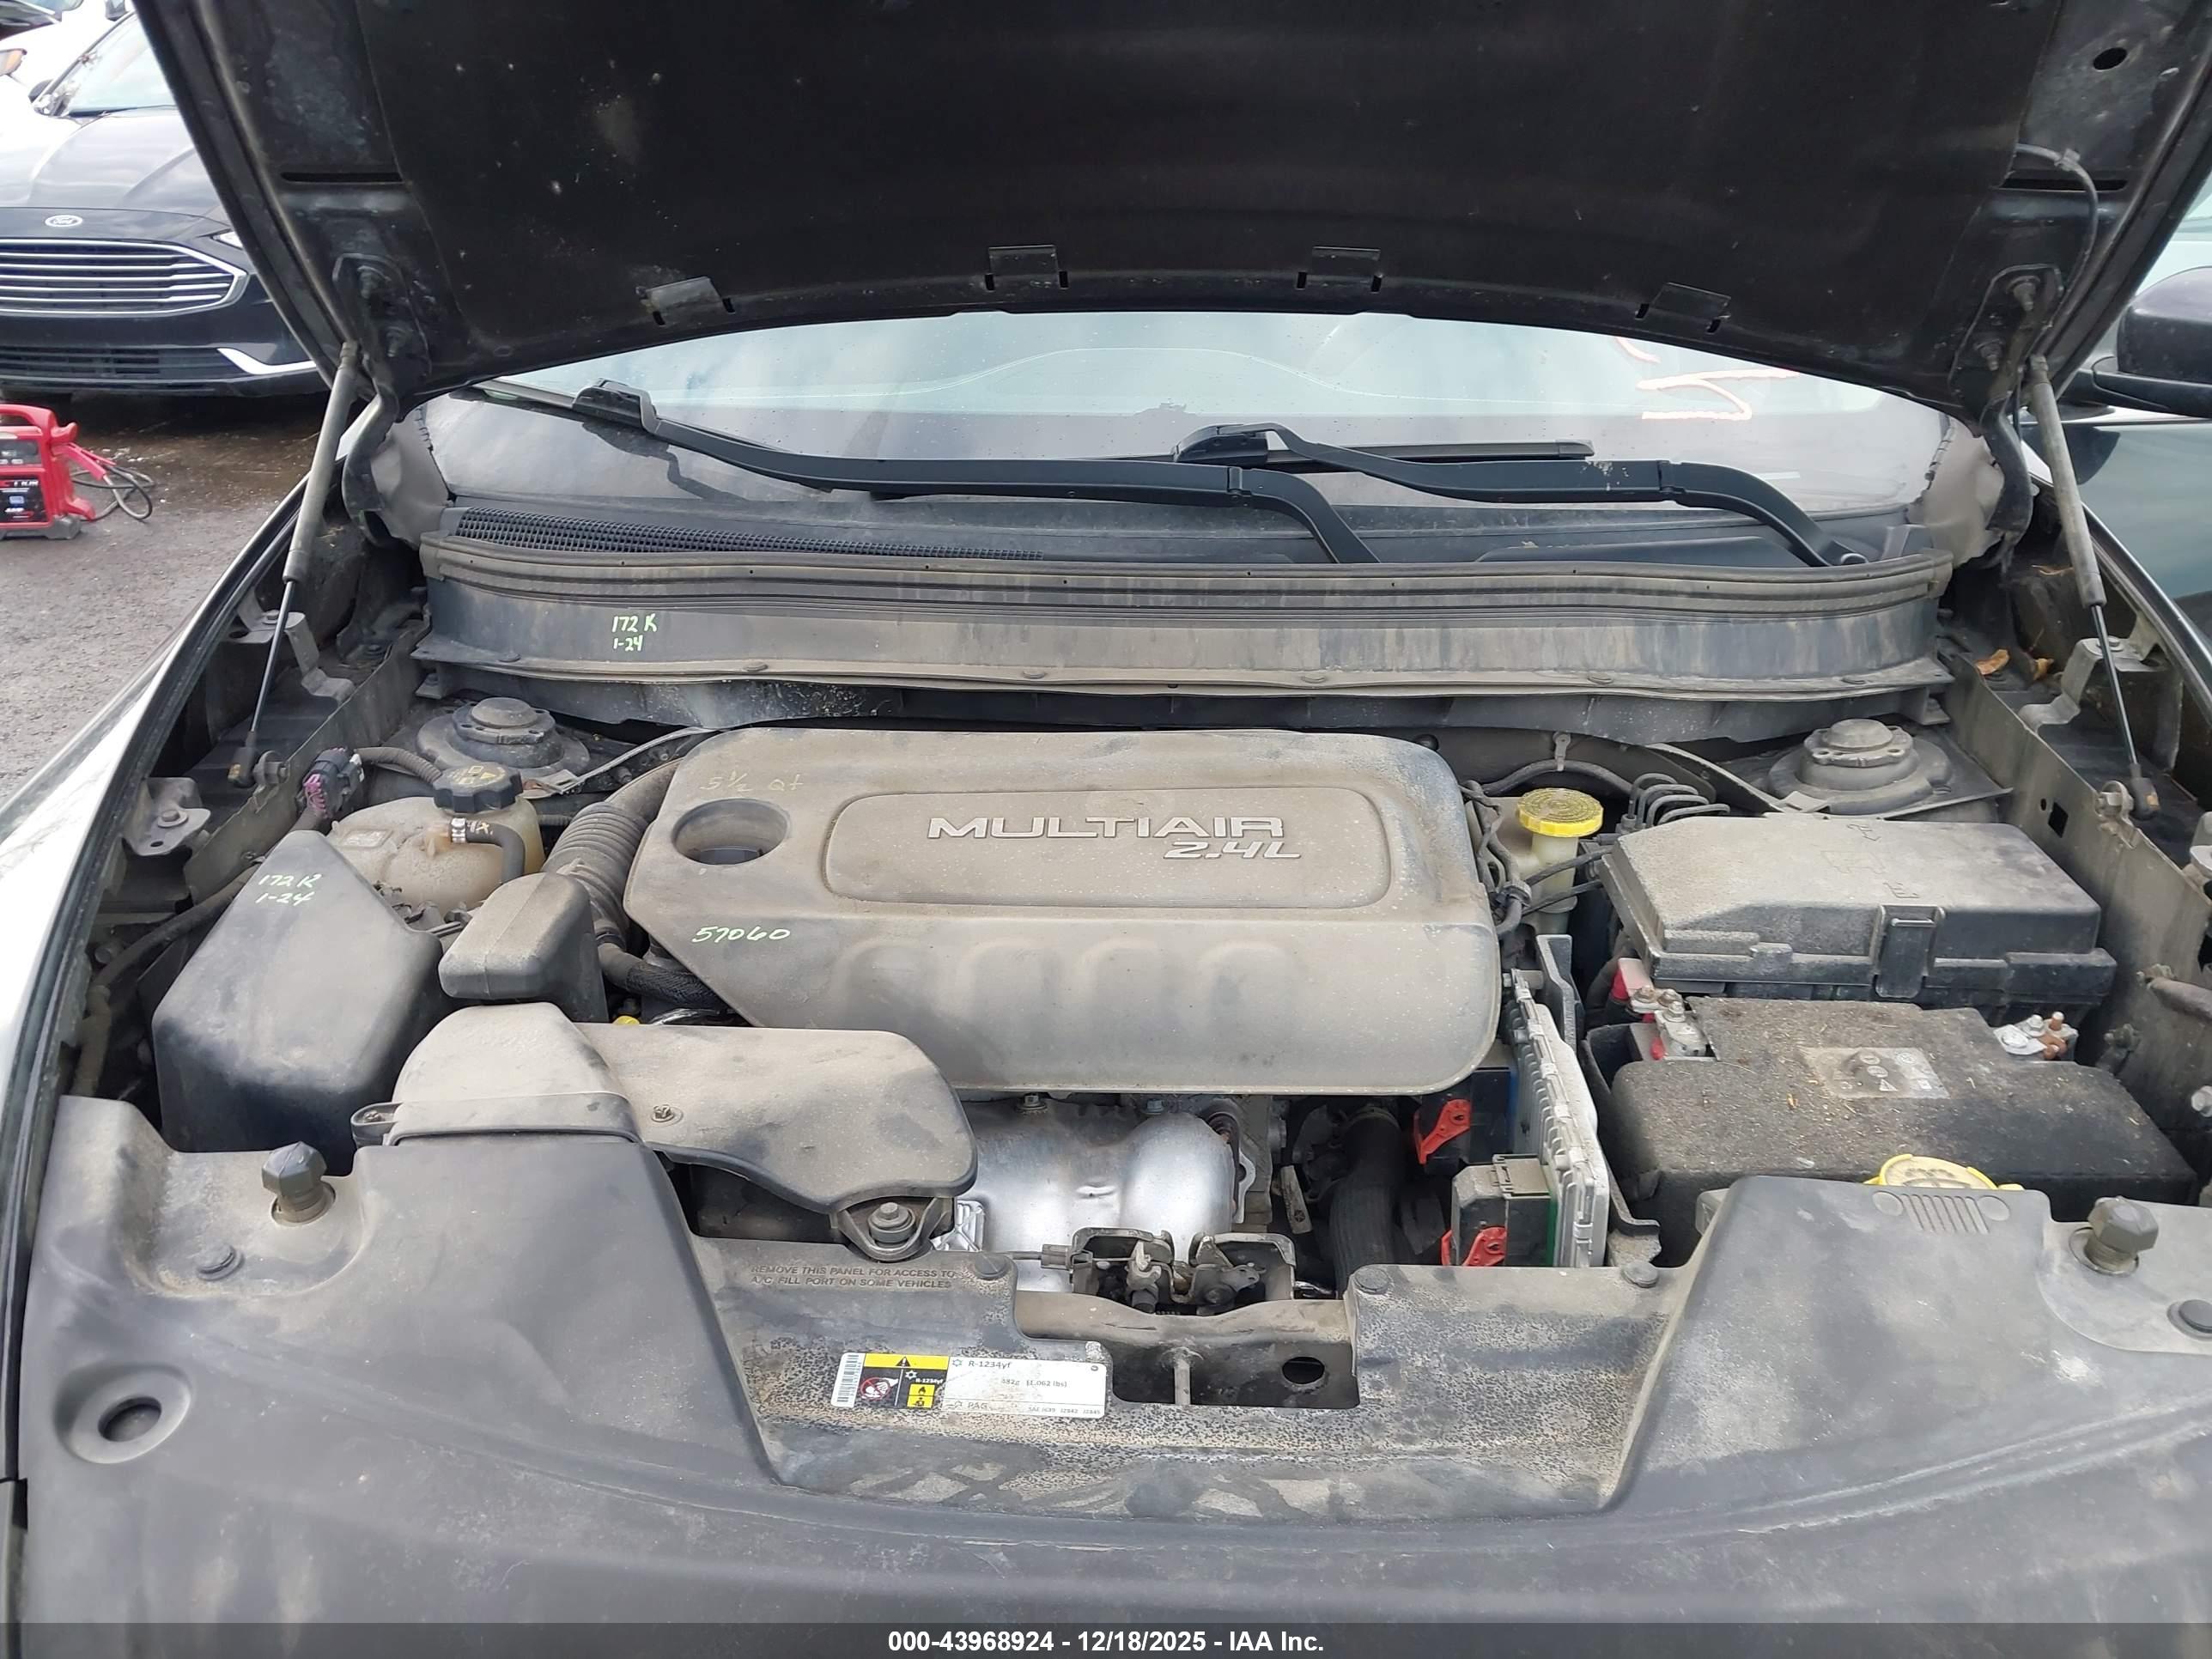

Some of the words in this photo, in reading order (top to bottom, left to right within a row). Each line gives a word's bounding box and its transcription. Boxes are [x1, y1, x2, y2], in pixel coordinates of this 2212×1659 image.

[612, 616, 638, 632] 172
[644, 613, 657, 632] K
[613, 635, 643, 651] 1-24
[927, 817, 1285, 838] MULTIAIR
[1163, 841, 1302, 860] 2.4L
[258, 874, 294, 887] 172
[296, 873, 322, 888] K
[255, 891, 315, 907] 1-24
[691, 927, 791, 943] 57060
[751, 1265, 799, 1274] REMOVE
[802, 1267, 826, 1275] THIS
[830, 1267, 866, 1276] PANEL
[869, 1268, 891, 1277] FOR
[894, 1269, 938, 1278] ACCESS
[941, 1270, 956, 1279] TO
[750, 1276, 773, 1285] A/C
[778, 1277, 800, 1285] FILL
[805, 1277, 836, 1285] PORT
[839, 1278, 857, 1286] ON
[860, 1279, 894, 1287] SOME
[897, 1279, 952, 1289] VEHICLES
[969, 1360, 1012, 1370] R-1234yf
